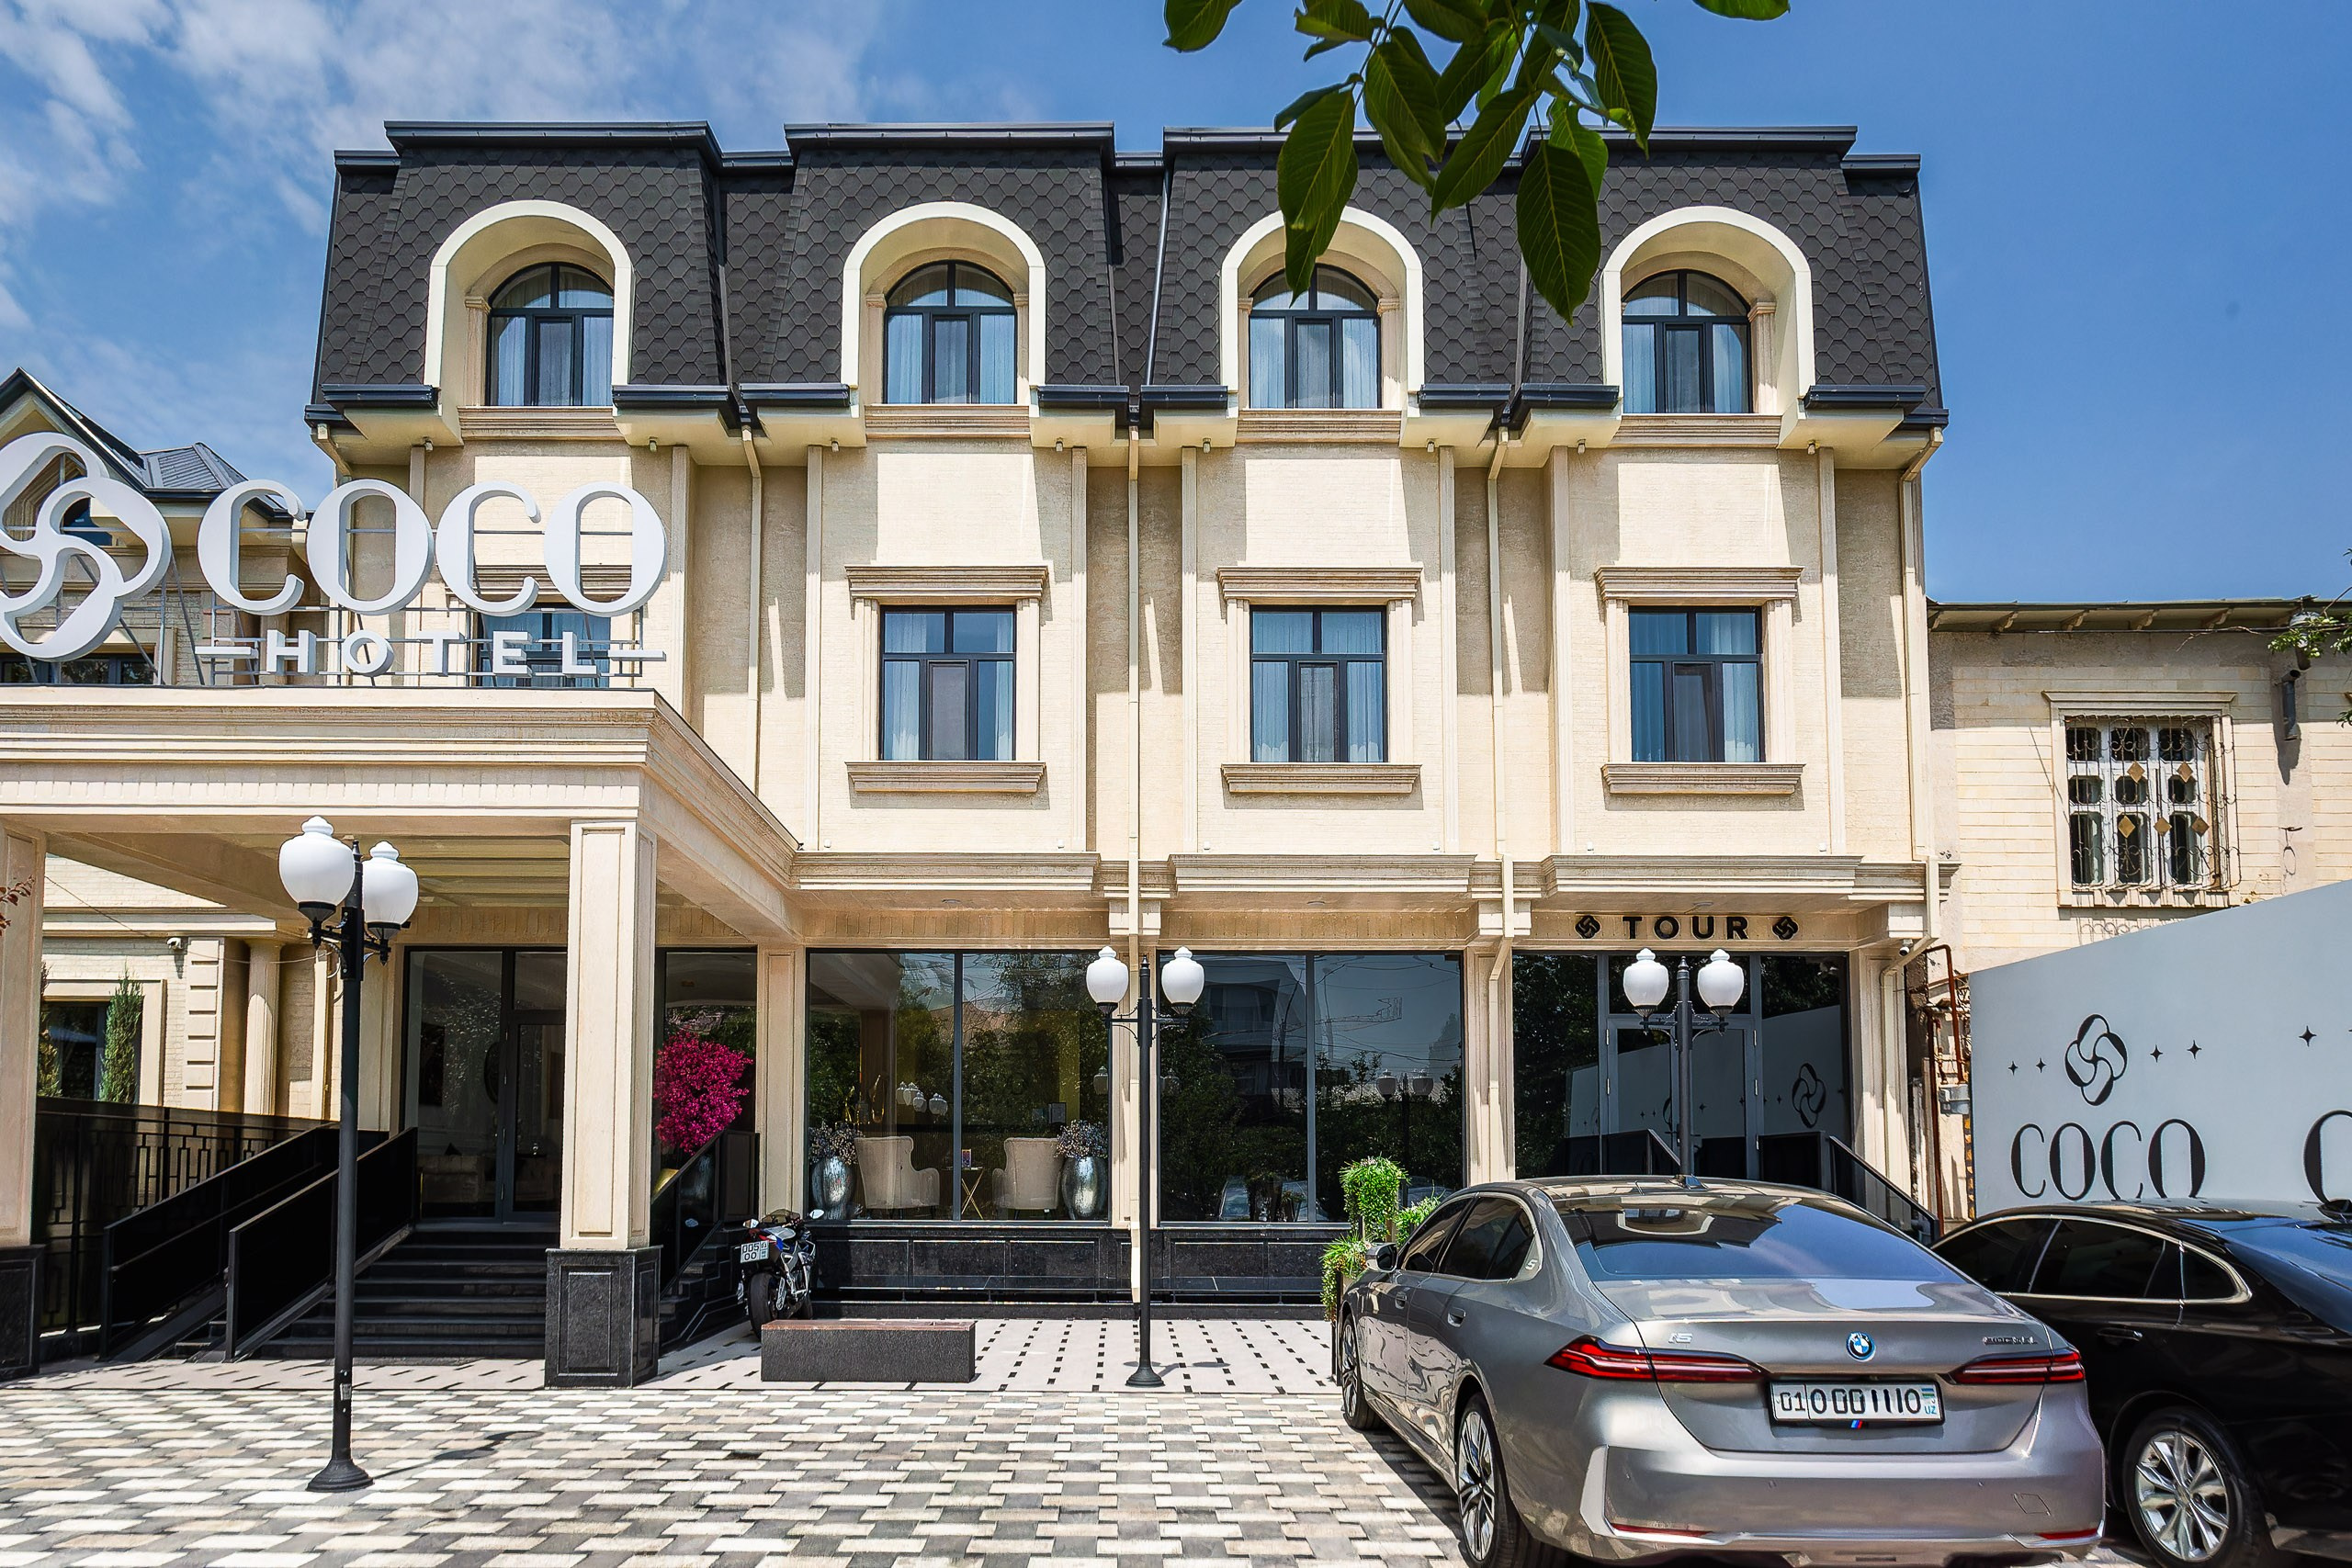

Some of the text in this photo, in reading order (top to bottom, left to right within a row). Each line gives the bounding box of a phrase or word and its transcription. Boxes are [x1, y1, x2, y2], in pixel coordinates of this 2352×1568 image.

[197, 479, 667, 617] COCO
[266, 629, 600, 678] HOTEL
[1622, 916, 1749, 941] TOUR
[2010, 1118, 2206, 1201] COCO
[1924, 1404, 1938, 1415] UZ
